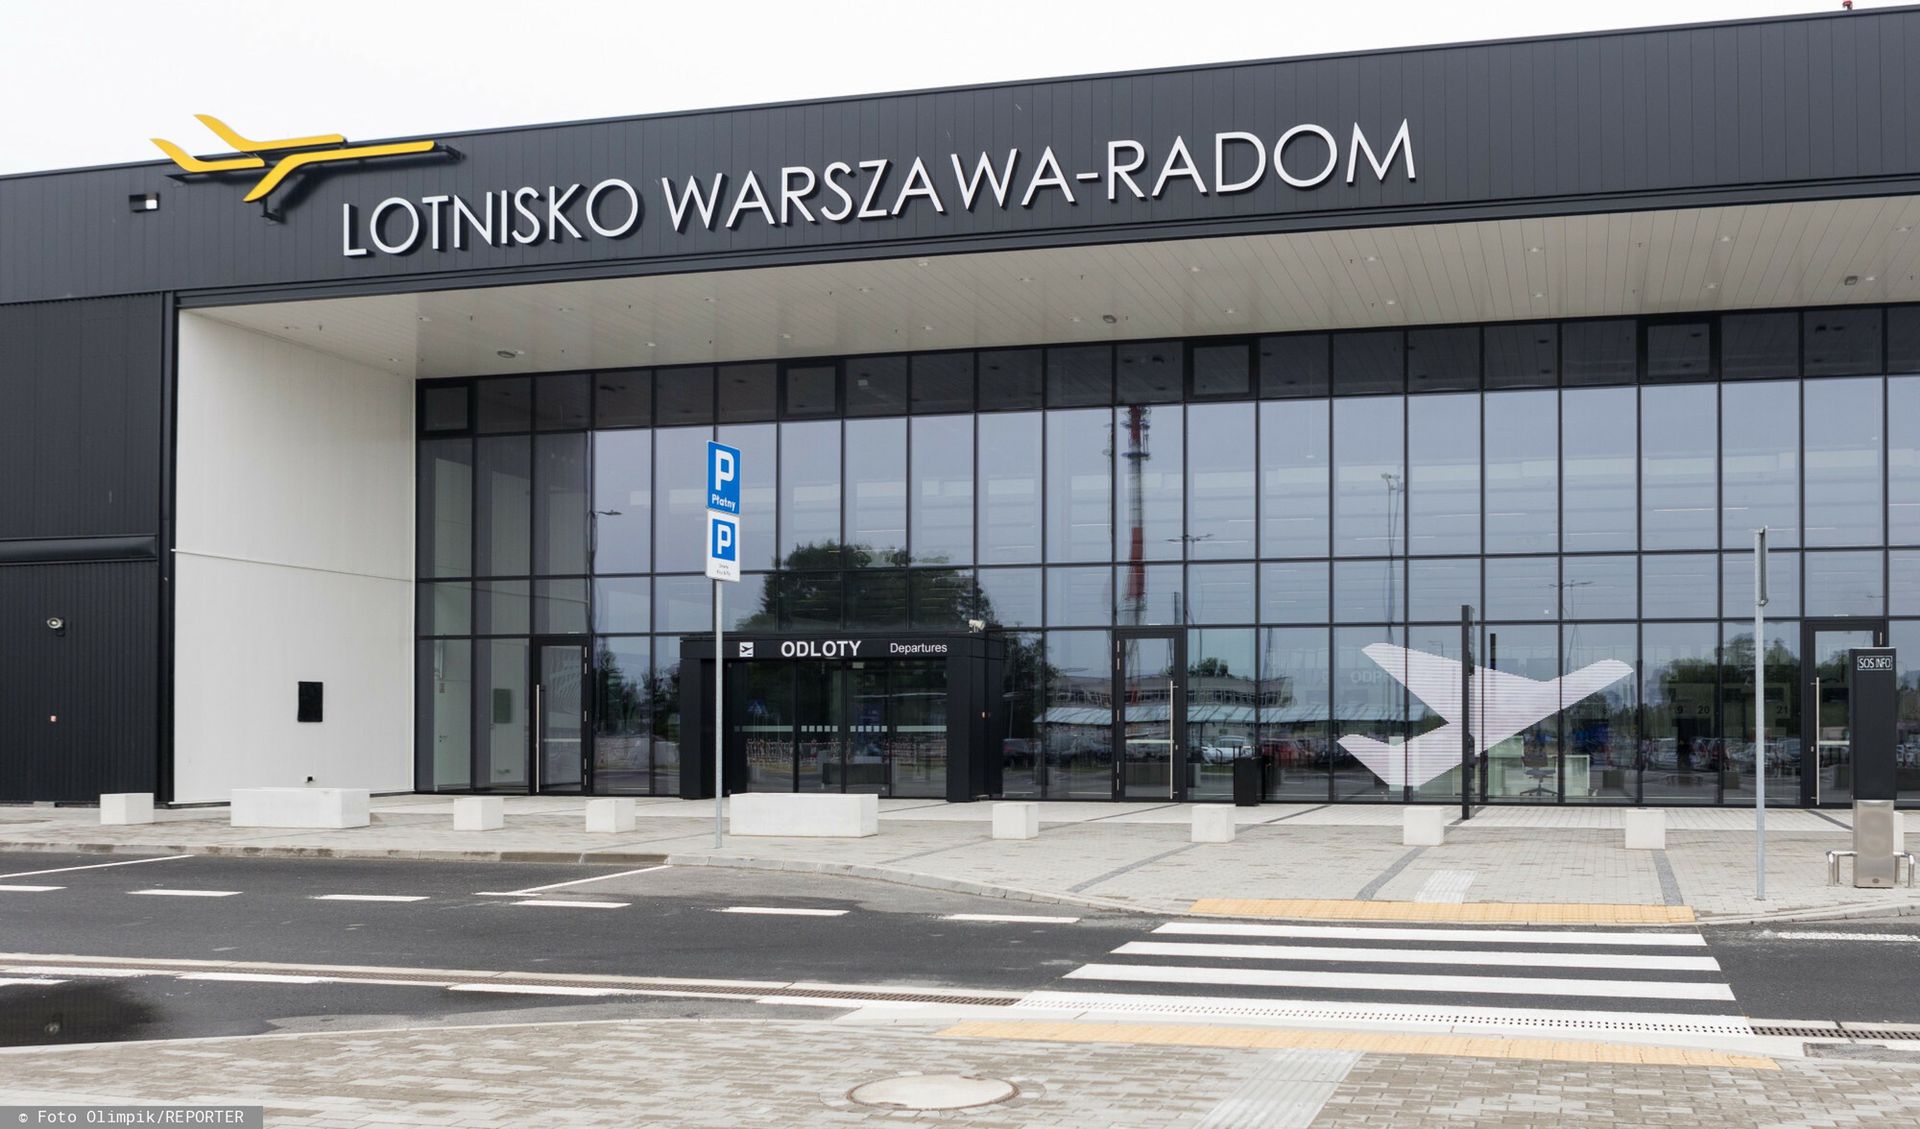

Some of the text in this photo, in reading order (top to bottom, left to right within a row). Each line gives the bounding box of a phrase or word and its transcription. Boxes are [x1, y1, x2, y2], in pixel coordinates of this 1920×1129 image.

[343, 118, 1417, 257] LOTNISKO WARSZAWA-RADOM
[715, 448, 735, 491] P
[711, 493, 736, 511] Płatny
[717, 523, 732, 555] P
[780, 640, 948, 658] ODLOTY Departures
[1859, 658, 1875, 669] SOS
